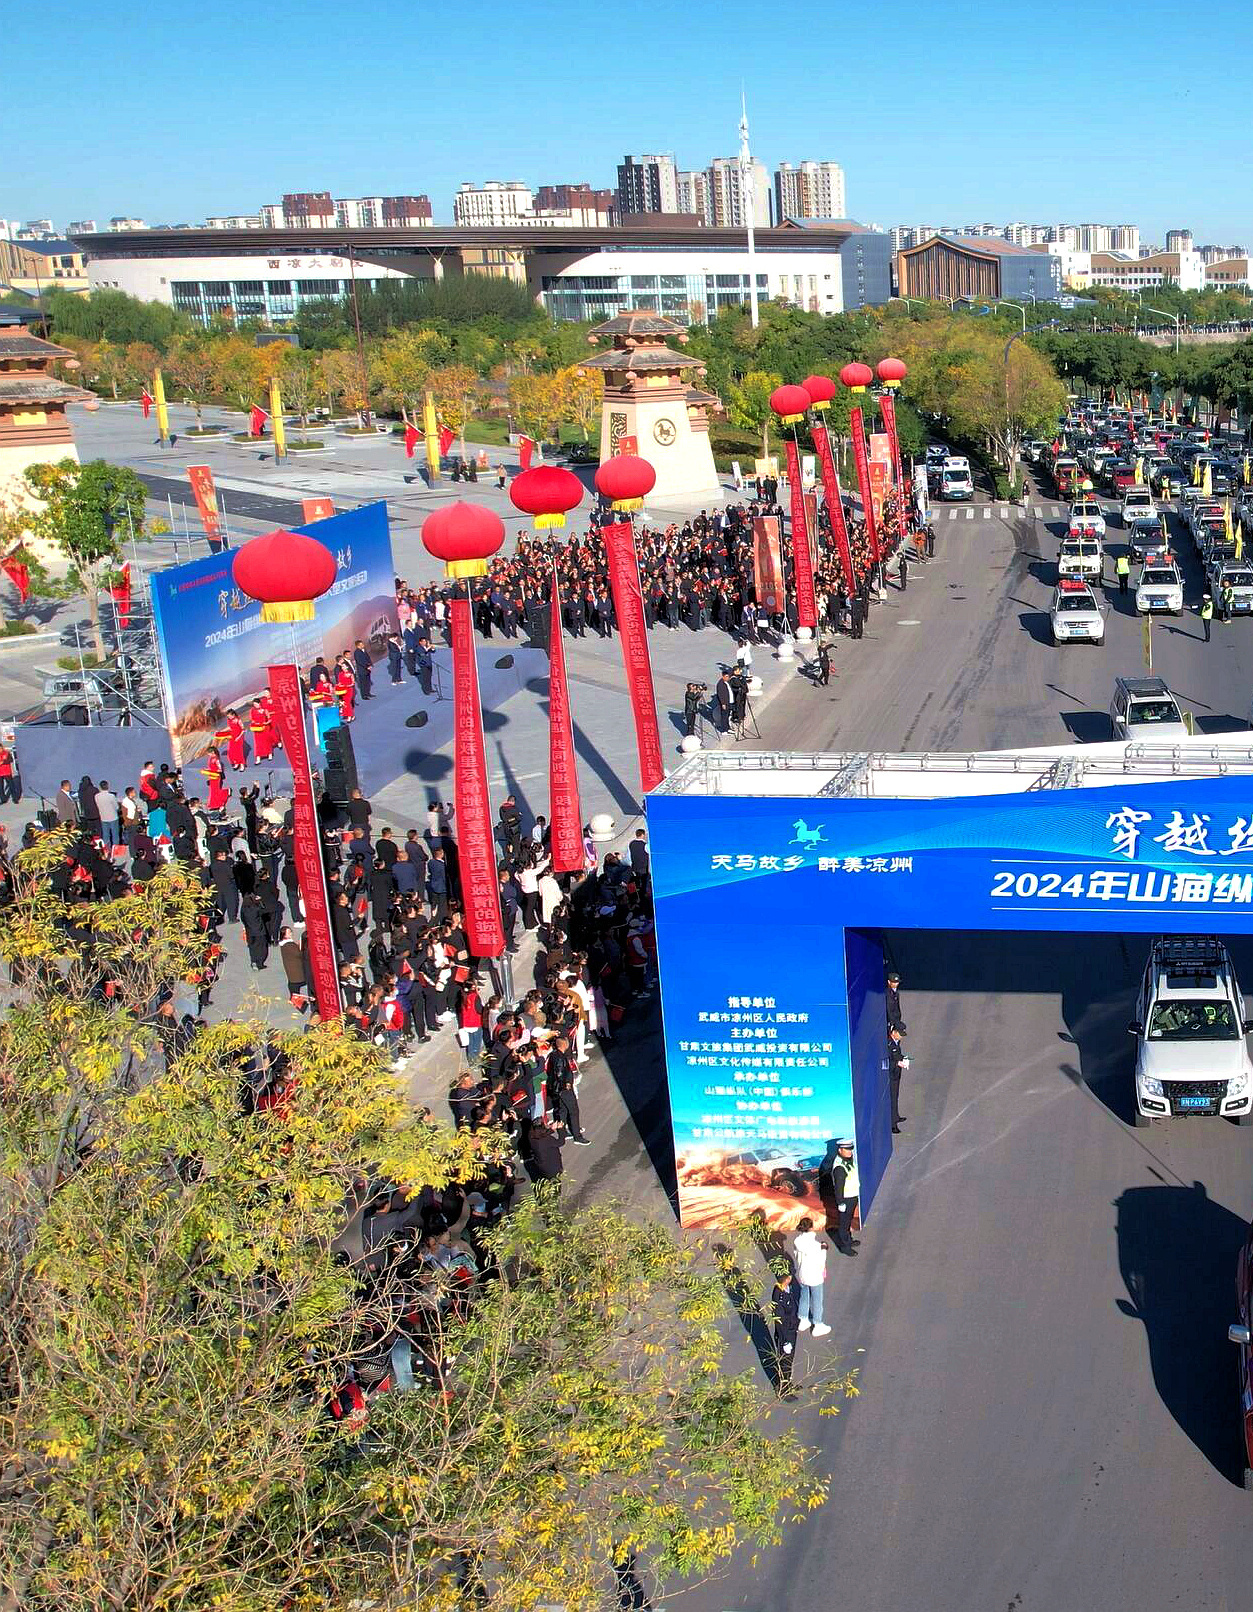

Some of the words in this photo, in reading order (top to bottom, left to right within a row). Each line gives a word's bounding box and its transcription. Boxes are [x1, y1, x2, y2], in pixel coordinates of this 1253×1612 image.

[711, 854, 804, 872] 天马故乡
[818, 855, 914, 874] 醉美凉州
[727, 996, 776, 1009] 指导单位
[698, 1012, 809, 1023] 武威市凉州区人民政府
[730, 1027, 778, 1039] 主办单位
